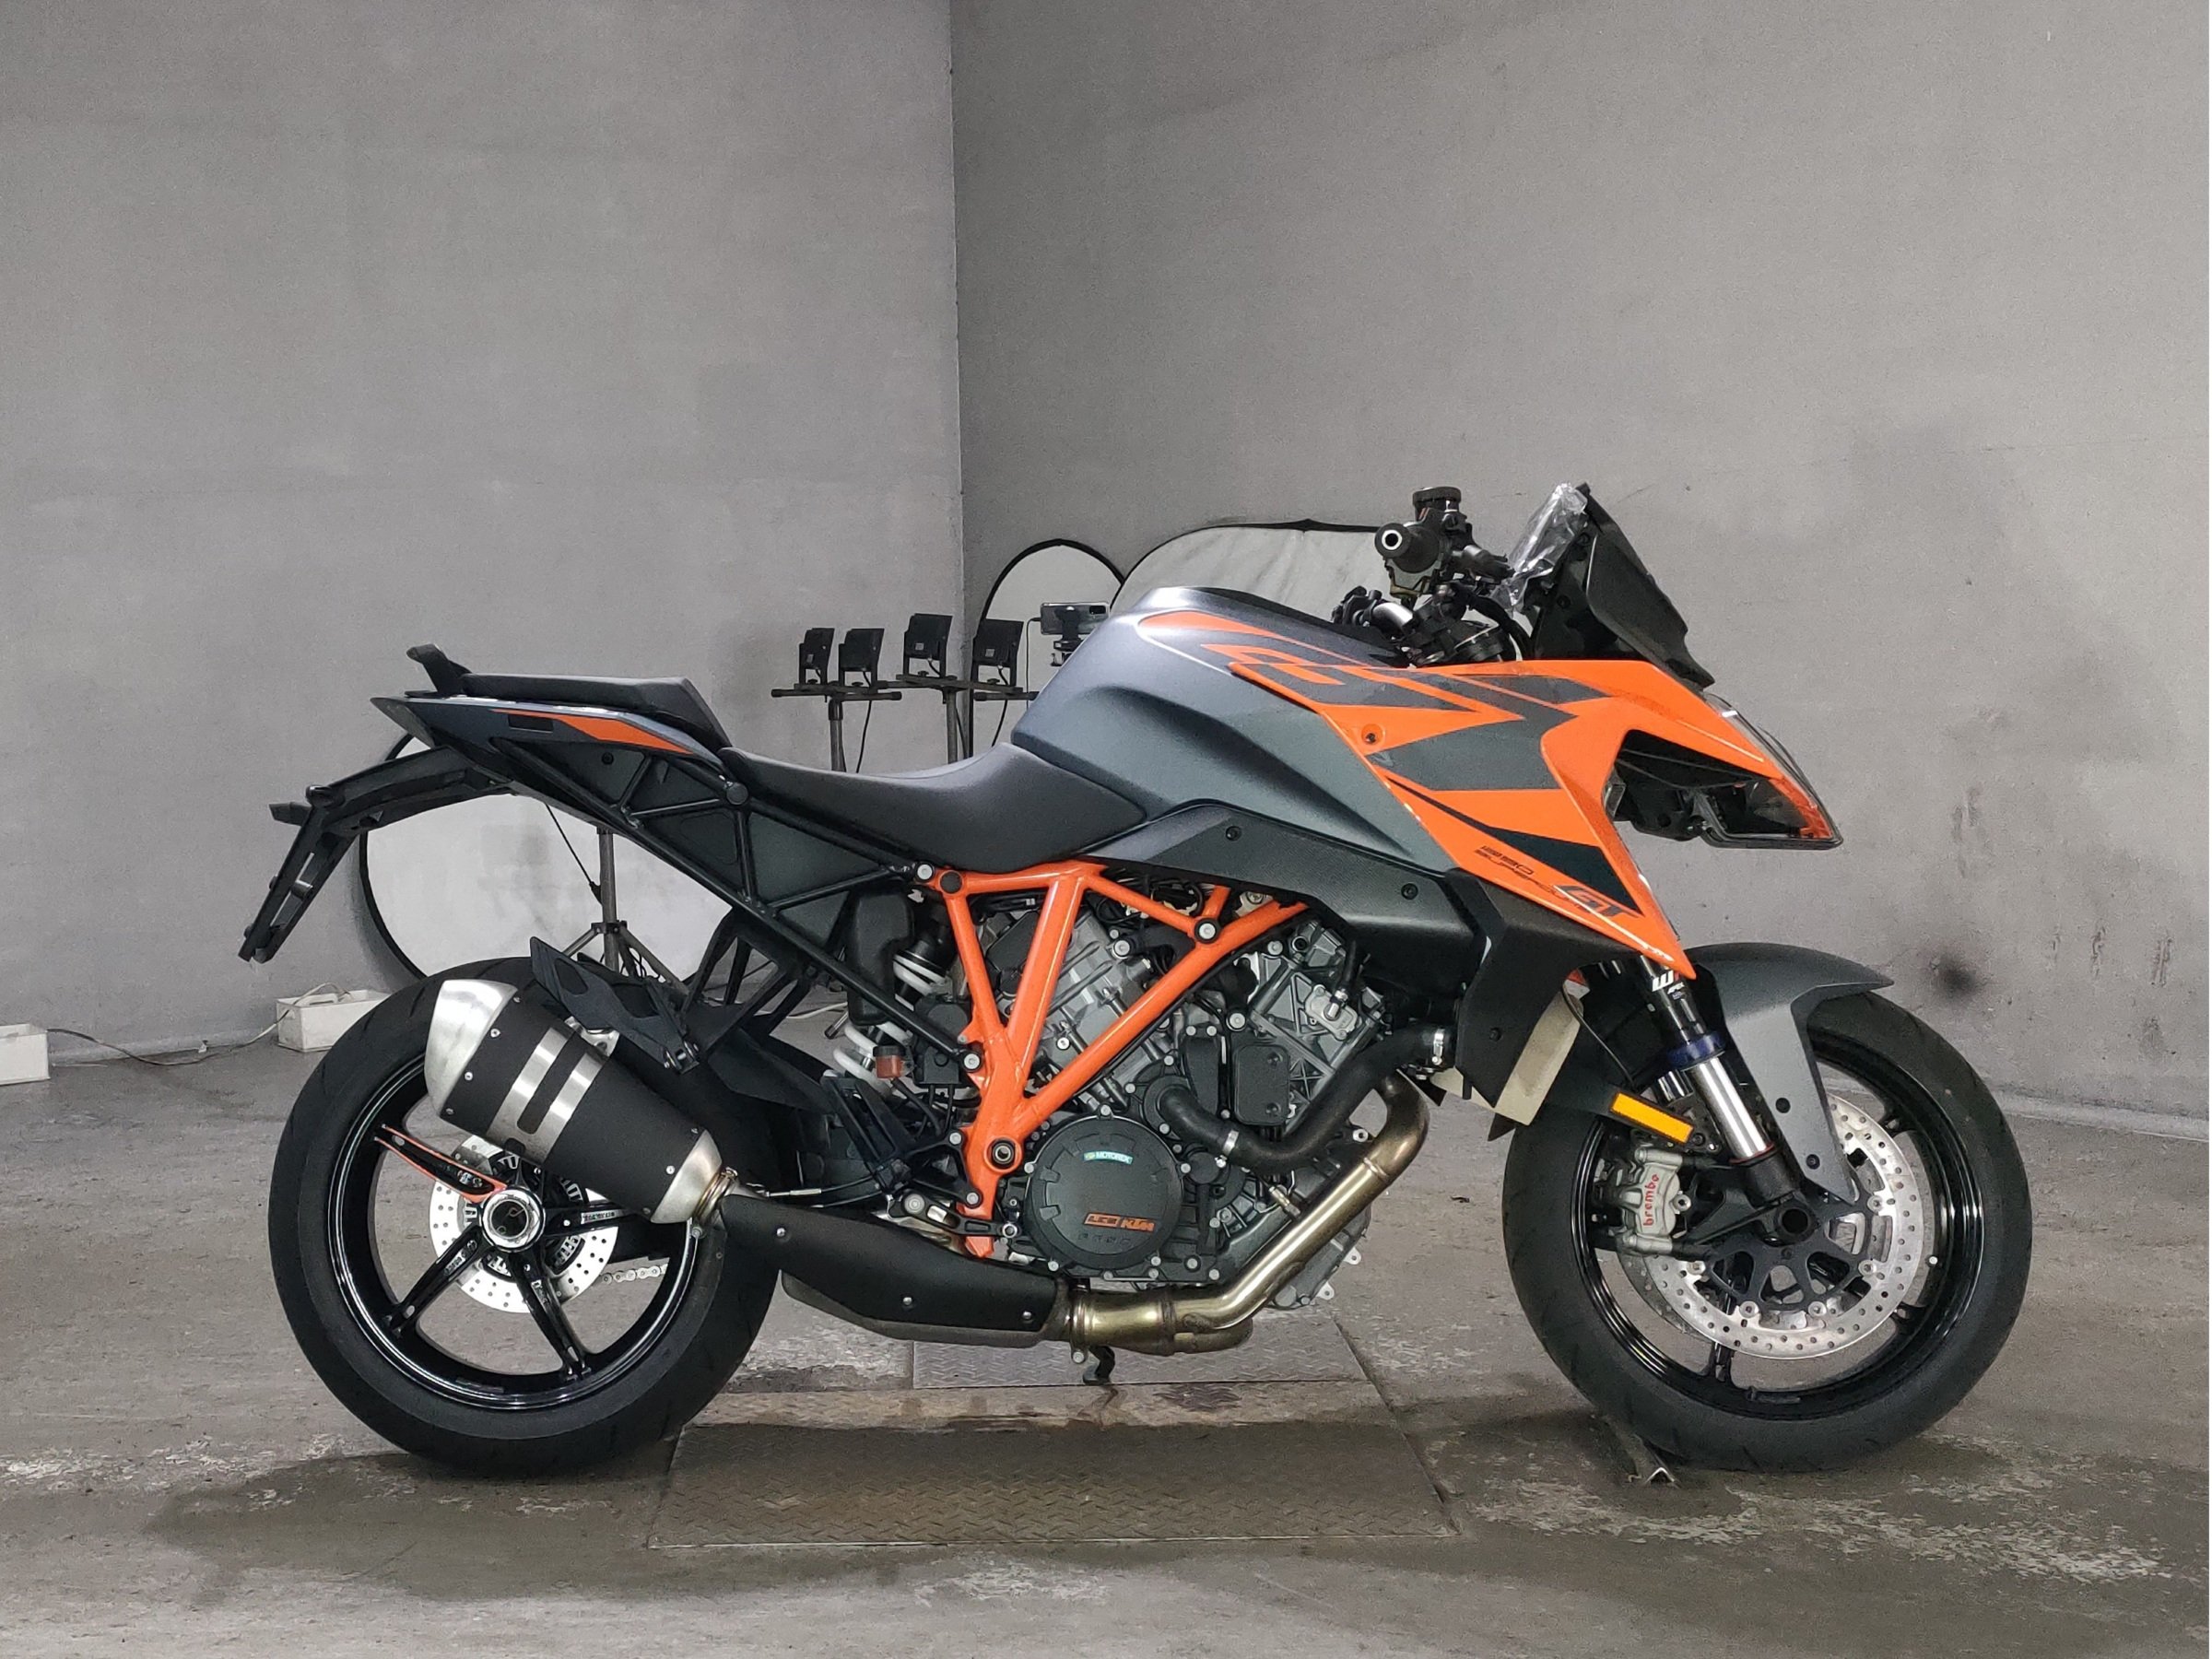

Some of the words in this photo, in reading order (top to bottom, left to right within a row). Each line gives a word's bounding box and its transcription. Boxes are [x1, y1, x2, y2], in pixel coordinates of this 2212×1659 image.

[1553, 884, 1638, 918] GT
[1095, 1151, 1133, 1165] MOTOREX
[1642, 1173, 1660, 1227] brembo
[1121, 1217, 1156, 1232] KTM
